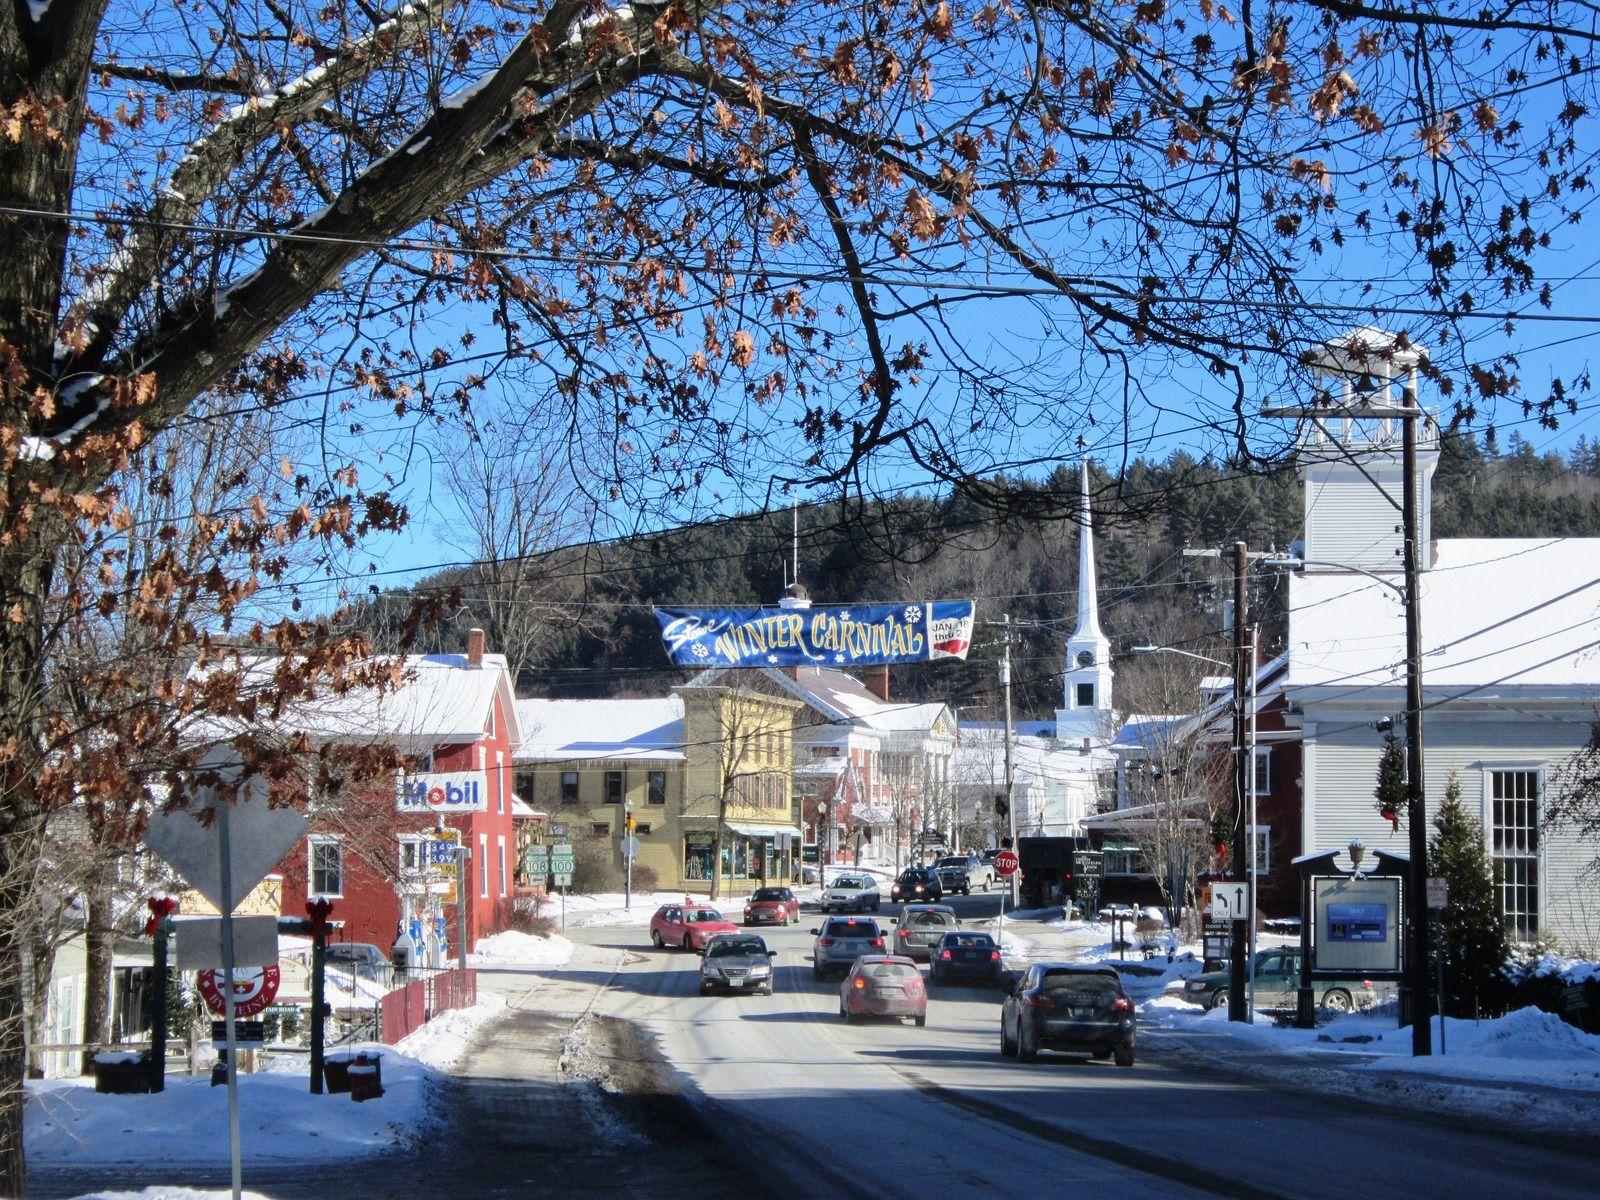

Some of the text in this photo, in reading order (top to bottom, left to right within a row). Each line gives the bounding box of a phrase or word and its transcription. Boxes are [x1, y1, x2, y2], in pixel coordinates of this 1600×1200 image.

[715, 613, 825, 664] WINTER
[811, 612, 924, 660] CARNIVAL
[934, 632, 955, 641] thru
[403, 780, 479, 806] Mobil
[528, 861, 547, 872] 108
[553, 861, 573, 872] 100
[995, 857, 1017, 868] STOP
[209, 994, 223, 1008] BY
